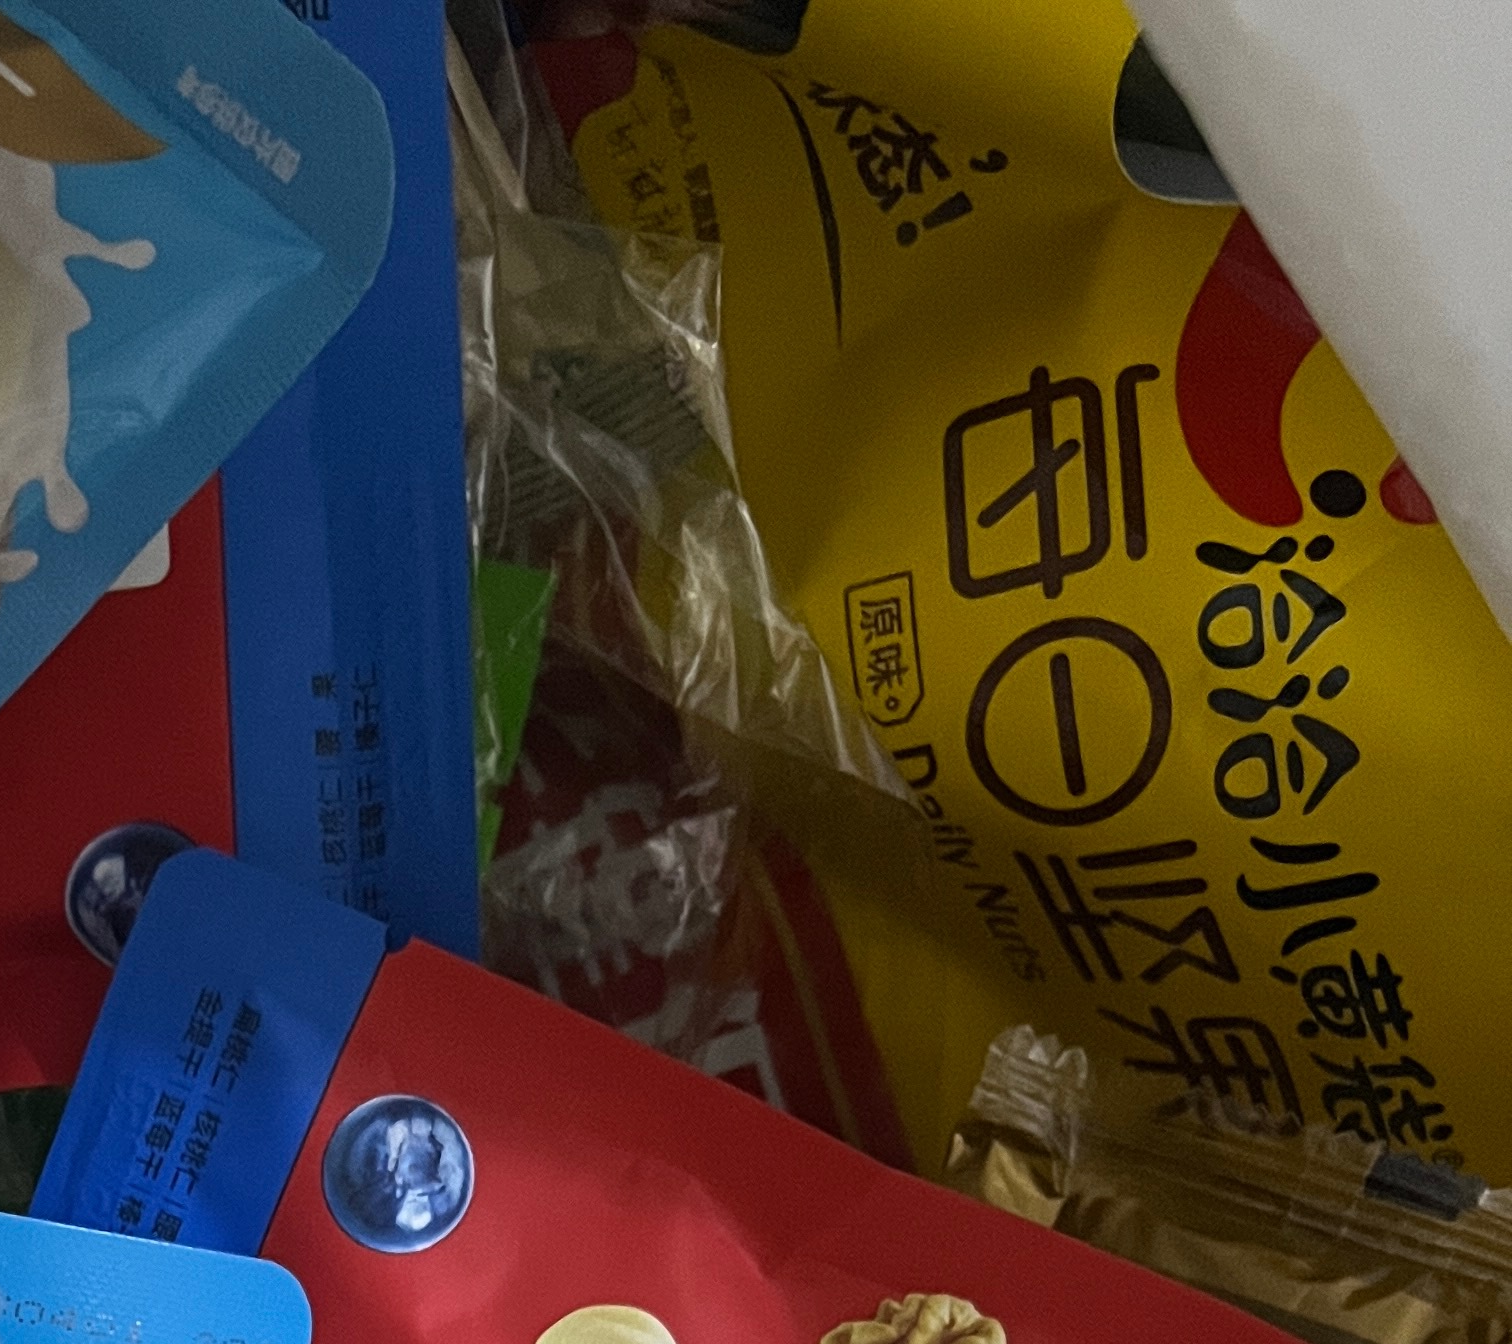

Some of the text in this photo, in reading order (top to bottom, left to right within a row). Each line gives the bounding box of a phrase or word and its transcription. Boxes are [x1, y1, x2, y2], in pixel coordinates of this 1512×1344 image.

[856, 597, 915, 697] 原味
[941, 363, 1304, 1138] 每日坚果
[964, 880, 1048, 983] Nuts
[1195, 535, 1456, 1145] 洽洽小黄袋
